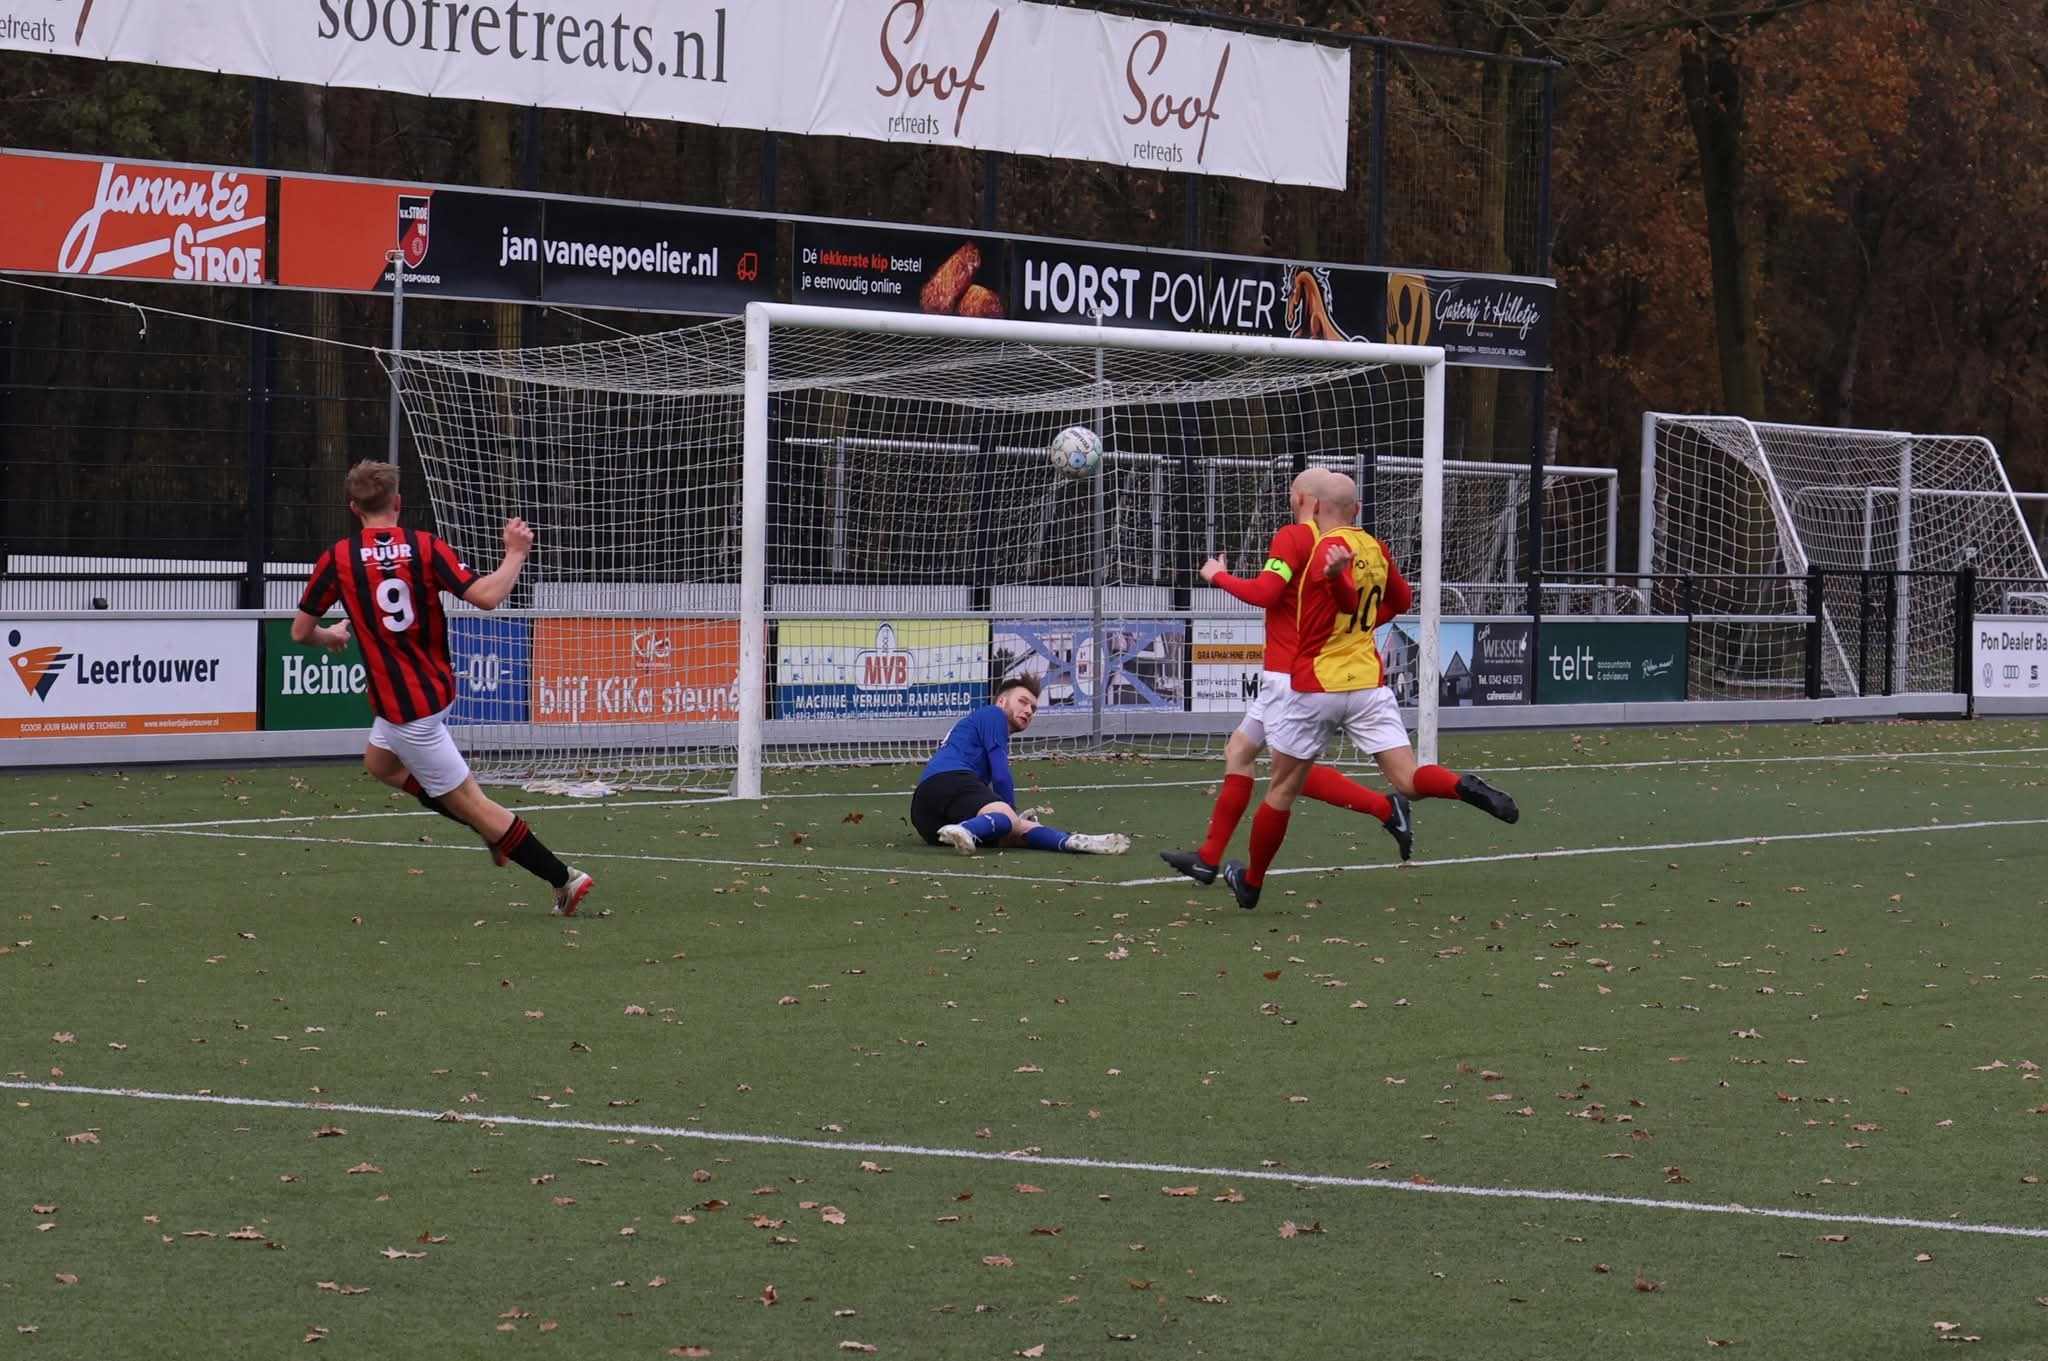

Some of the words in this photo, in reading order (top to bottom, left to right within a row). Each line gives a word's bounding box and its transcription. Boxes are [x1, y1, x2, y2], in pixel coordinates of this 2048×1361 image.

[876, 0, 1000, 138] Soof
[1123, 29, 1231, 165] Soof
[888, 114, 940, 136] retreats
[1133, 140, 1183, 163] retreats
[499, 226, 538, 267] jan
[543, 238, 719, 277] vaneepoelier.nl
[802, 247, 818, 265] Dé
[819, 249, 869, 269] lekkerste
[871, 254, 889, 273] kip
[890, 255, 922, 273] bestel
[801, 272, 812, 290] je
[813, 275, 869, 295] eenvoudig
[870, 278, 903, 295] online
[1024, 258, 1141, 319] HORST
[1150, 271, 1276, 330] POWER
[360, 543, 412, 562] PUUR
[376, 578, 415, 632] 9
[1980, 631, 1999, 651] Pon
[2002, 631, 2034, 651] Dealer
[77, 653, 220, 685] Leertouwer
[281, 654, 369, 695] Heine
[863, 655, 908, 685] MVB
[1548, 645, 1594, 681] telt
[540, 675, 589, 723] blijf
[597, 675, 653, 714] KiKa
[795, 694, 847, 709] MACHINE
[852, 693, 903, 707] VERHUUR
[908, 692, 971, 706] BARNEVELD
